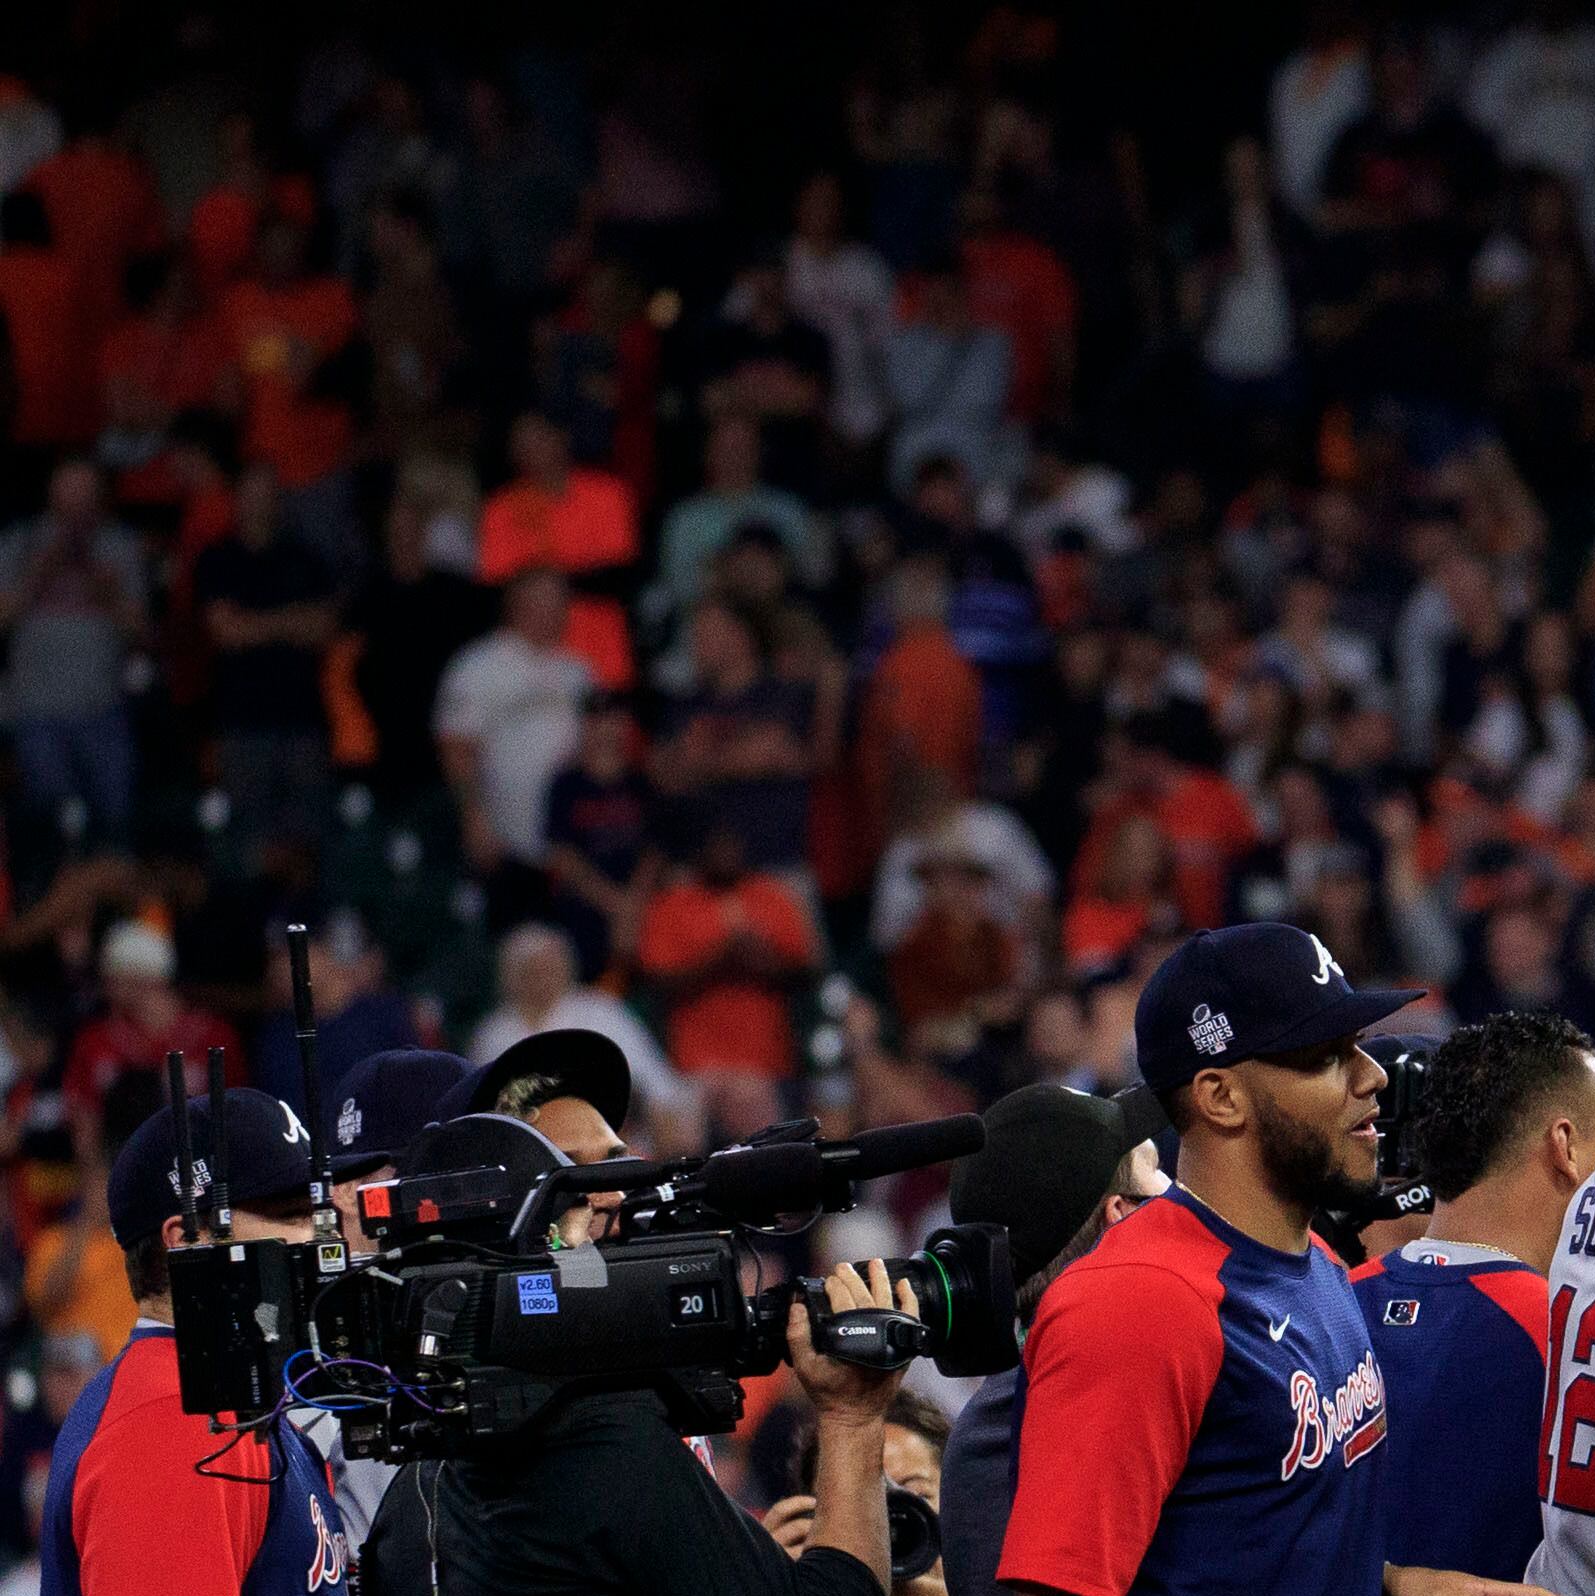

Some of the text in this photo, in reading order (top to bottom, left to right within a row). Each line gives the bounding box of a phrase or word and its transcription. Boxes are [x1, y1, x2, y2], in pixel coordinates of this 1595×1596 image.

[1188, 1015, 1229, 1041] WORLD
[1193, 1026, 1234, 1051] SERIES
[668, 1261, 712, 1275] SONY
[521, 1298, 556, 1312] 1080p
[679, 1295, 704, 1314] 20
[838, 1326, 877, 1336] Canon
